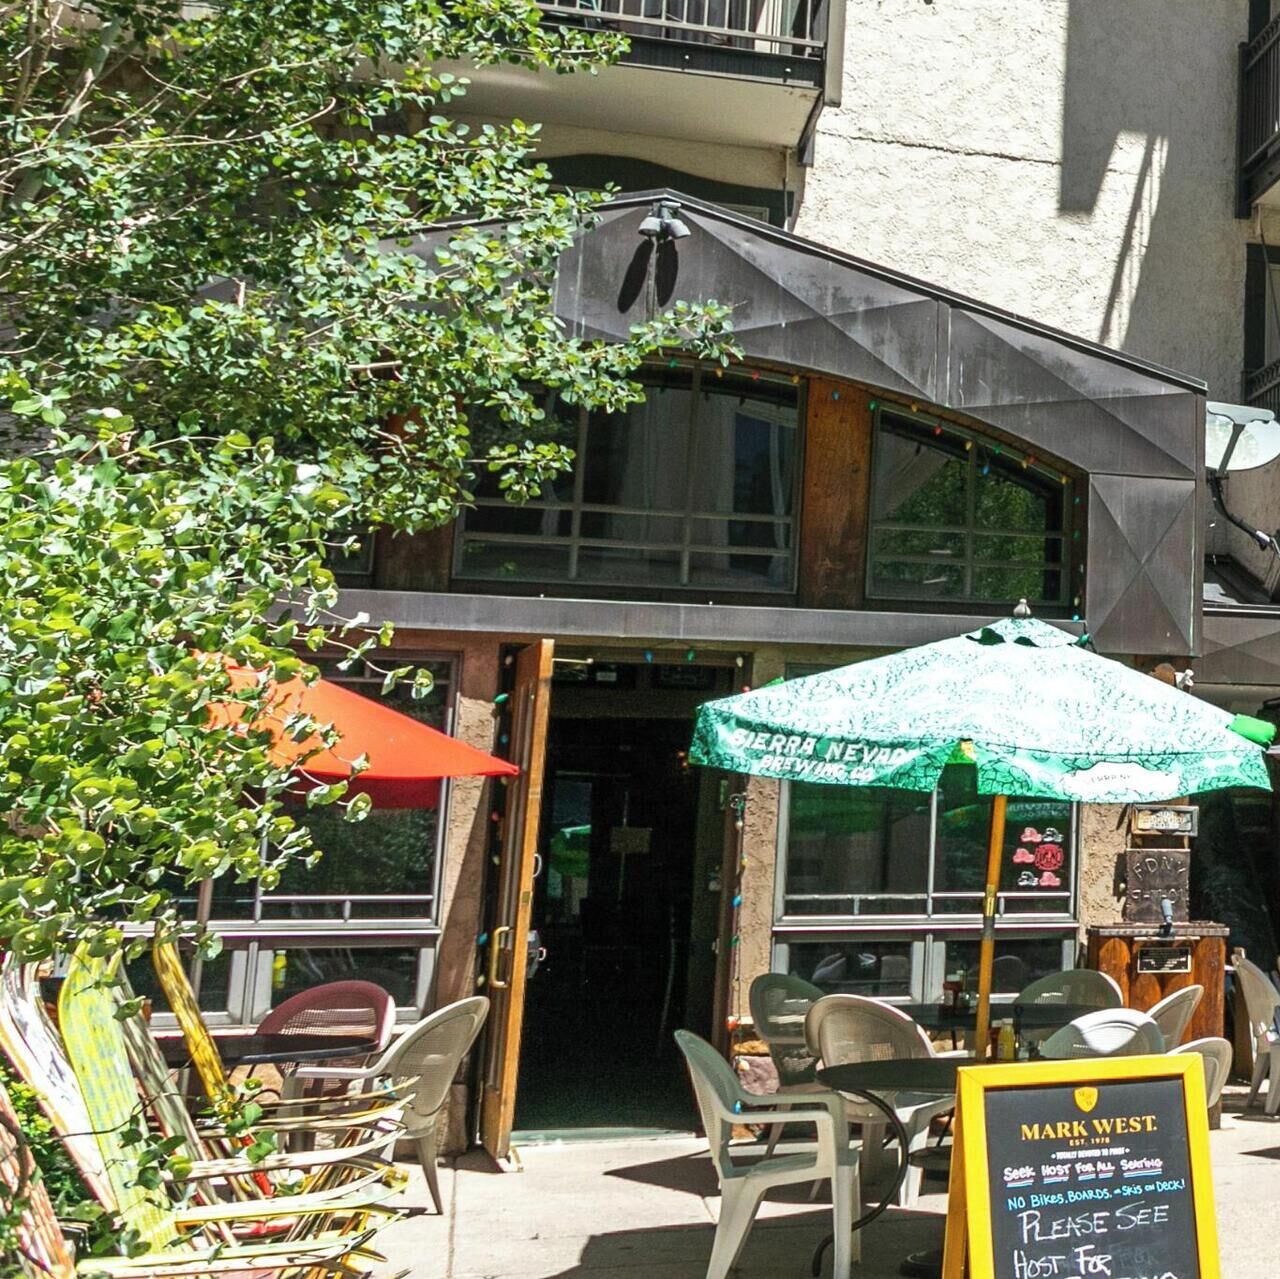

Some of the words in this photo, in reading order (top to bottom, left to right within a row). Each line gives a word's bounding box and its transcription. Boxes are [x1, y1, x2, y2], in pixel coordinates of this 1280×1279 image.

[728, 727, 817, 756] SIERRA
[759, 754, 846, 780] BREWING
[1020, 1120, 1088, 1141] MARK
[1041, 1162, 1072, 1178] HOST
[1096, 1160, 1116, 1173] ALL
[1007, 1196, 1026, 1211] NO
[1016, 1209, 1111, 1245] PLEASE
[1115, 1200, 1170, 1231] SEE
[1013, 1248, 1067, 1279] HOST
[1073, 1244, 1113, 1277] FOR
